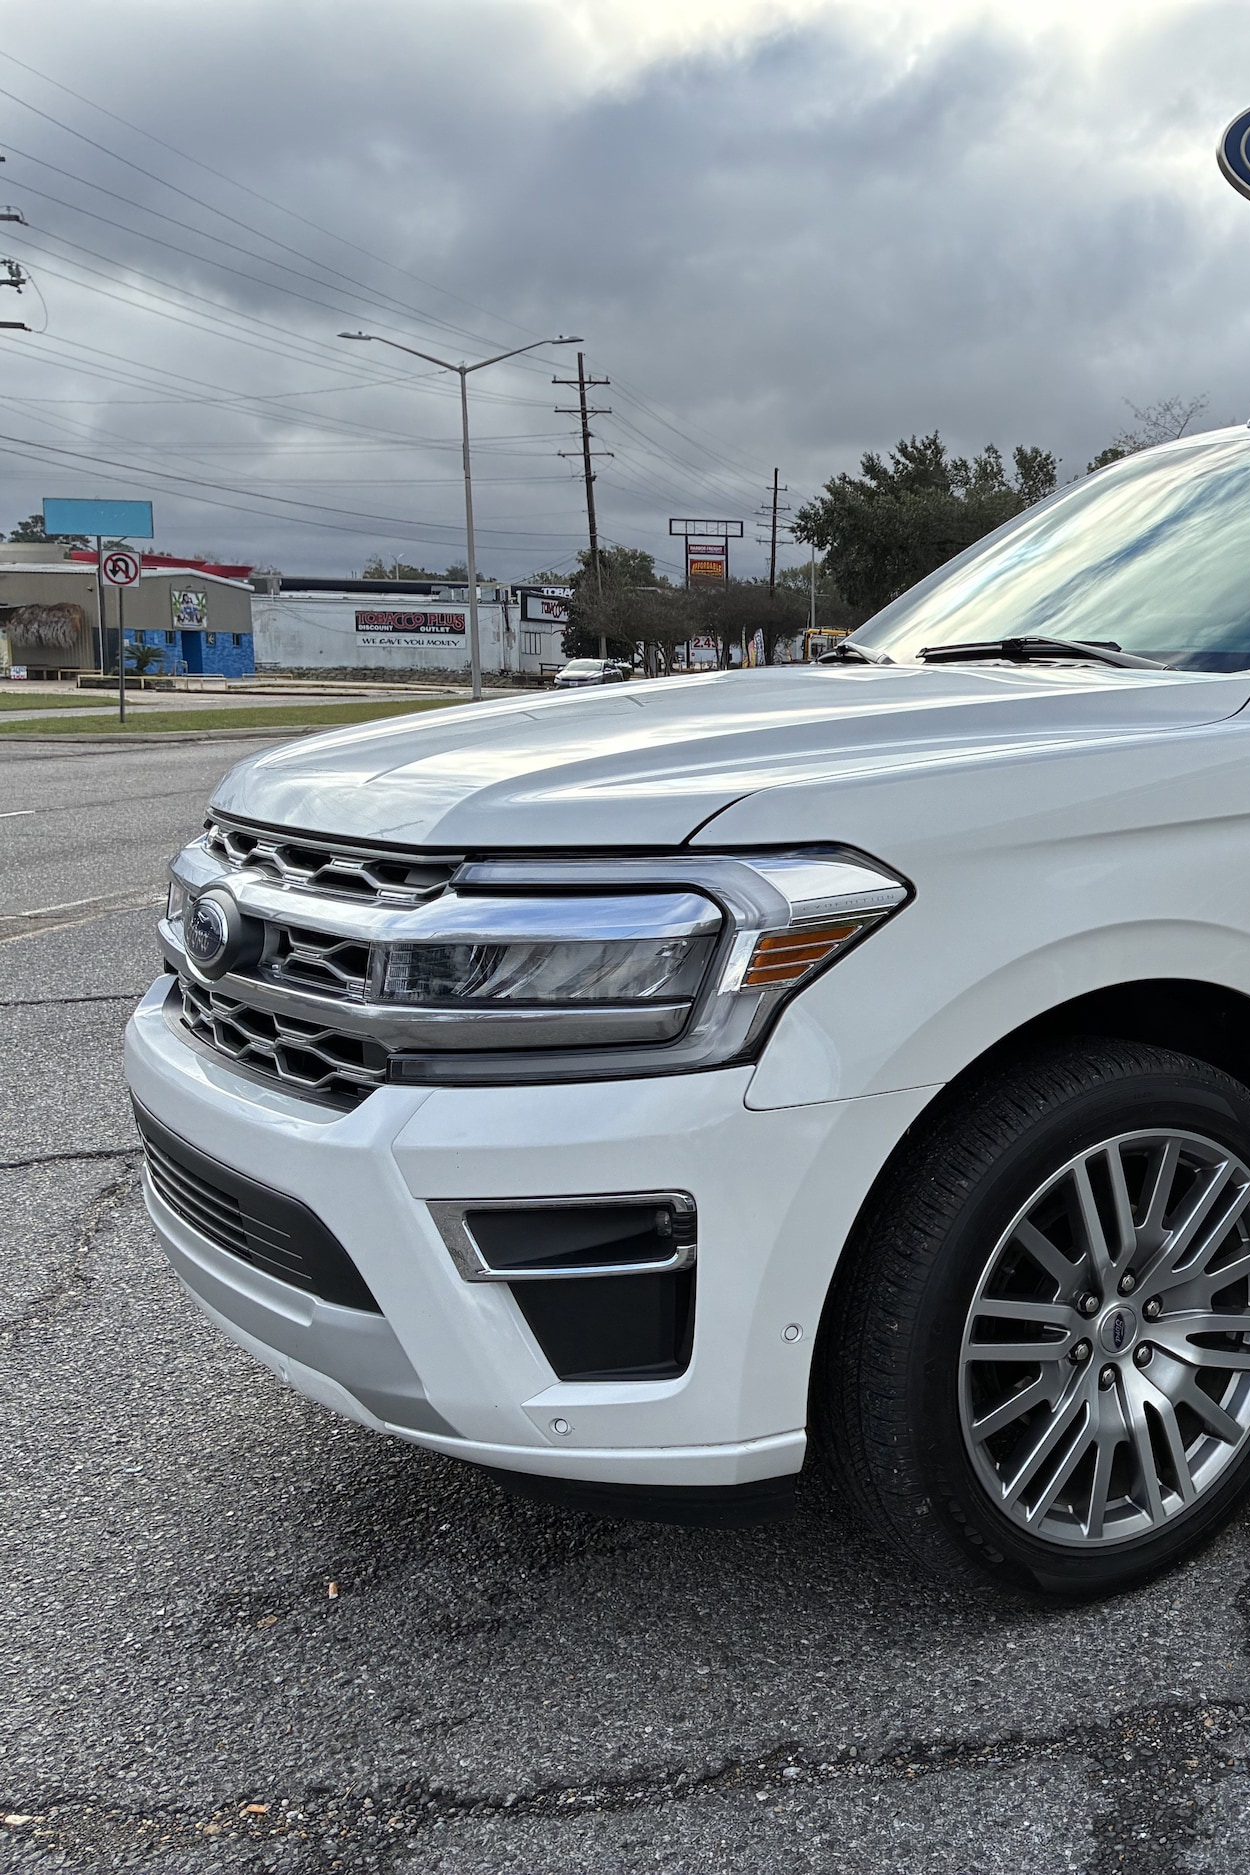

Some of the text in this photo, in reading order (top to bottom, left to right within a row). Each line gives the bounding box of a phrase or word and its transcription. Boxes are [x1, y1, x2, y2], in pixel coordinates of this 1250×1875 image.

[355, 611, 465, 631] TOBACCO PLUS
[358, 624, 394, 632] DISCOUNT
[404, 639, 425, 647] YOU
